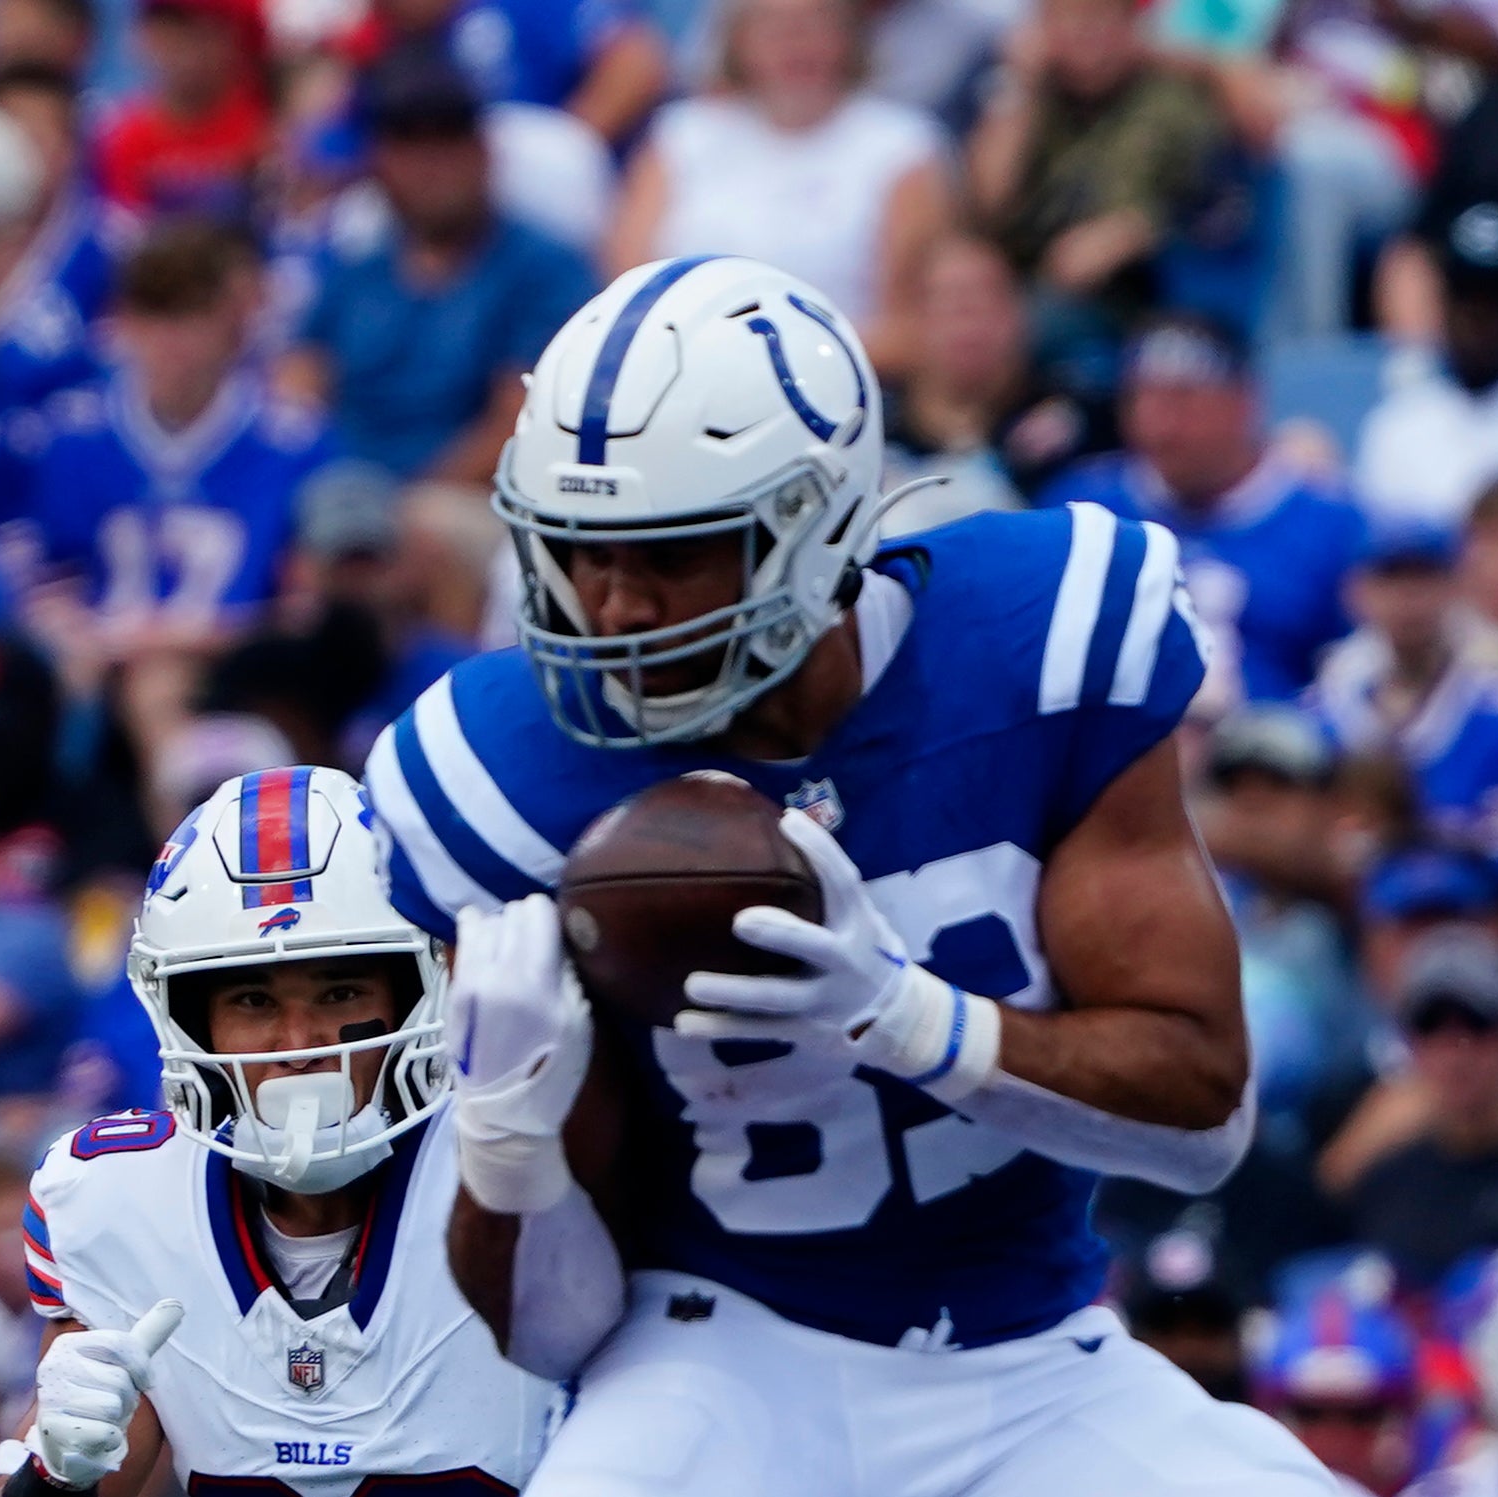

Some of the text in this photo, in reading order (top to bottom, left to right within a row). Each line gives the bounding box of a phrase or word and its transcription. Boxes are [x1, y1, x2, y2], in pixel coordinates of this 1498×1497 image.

[559, 475, 618, 495] COLTS
[99, 505, 243, 625] 17
[293, 1365, 320, 1384] NFL
[274, 1442, 353, 1465] BILLS
